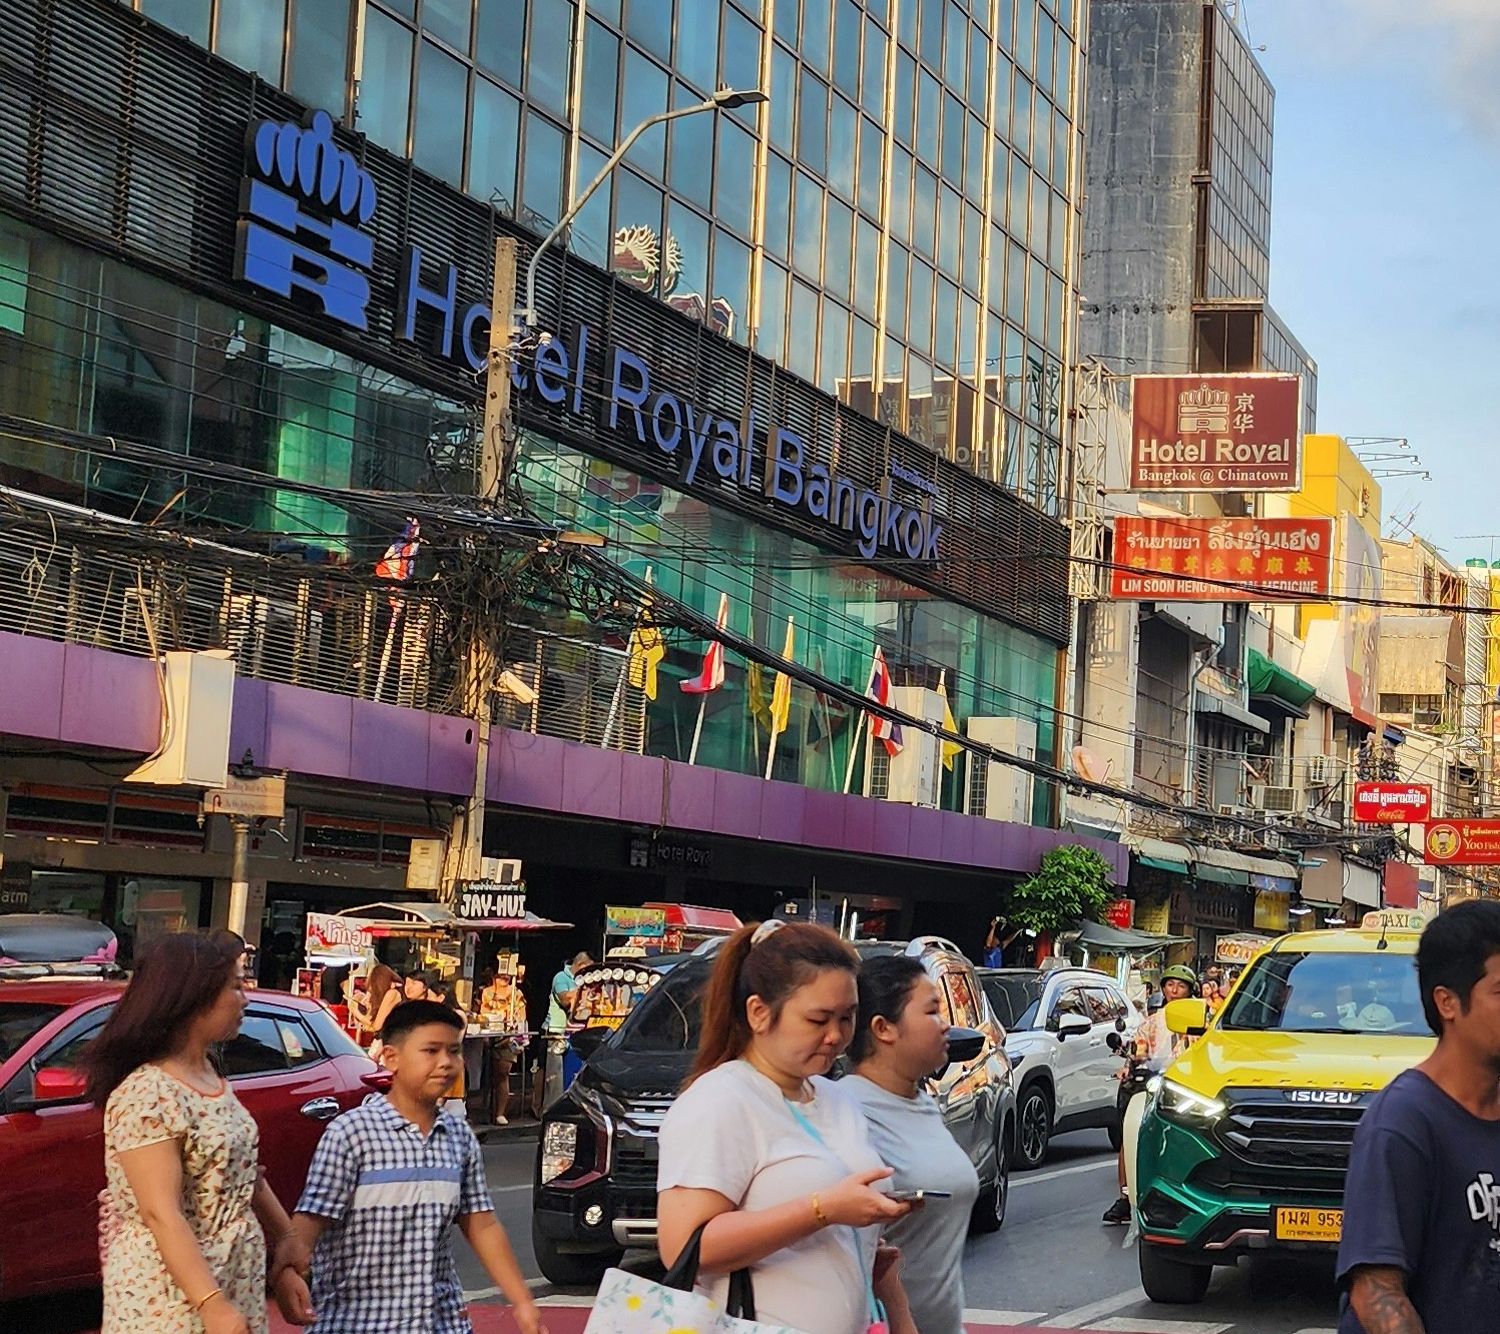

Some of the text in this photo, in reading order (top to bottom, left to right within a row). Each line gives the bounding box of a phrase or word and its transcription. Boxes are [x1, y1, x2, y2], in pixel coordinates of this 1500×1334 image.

[1233, 393, 1255, 434] 京华
[610, 347, 755, 486] Royal
[773, 428, 940, 560] Bangkok
[1138, 439, 1289, 464] Hotel Royal
[1139, 469, 1196, 484] Bangkok
[1217, 469, 1288, 482] Chinatown
[1122, 580, 1142, 592] LIM
[1144, 580, 1175, 593] SOON
[1177, 580, 1207, 593] HENG
[460, 894, 526, 917] JAY-HUI
[1379, 914, 1409, 928] TAXI
[1291, 1090, 1352, 1103] ISUZU
